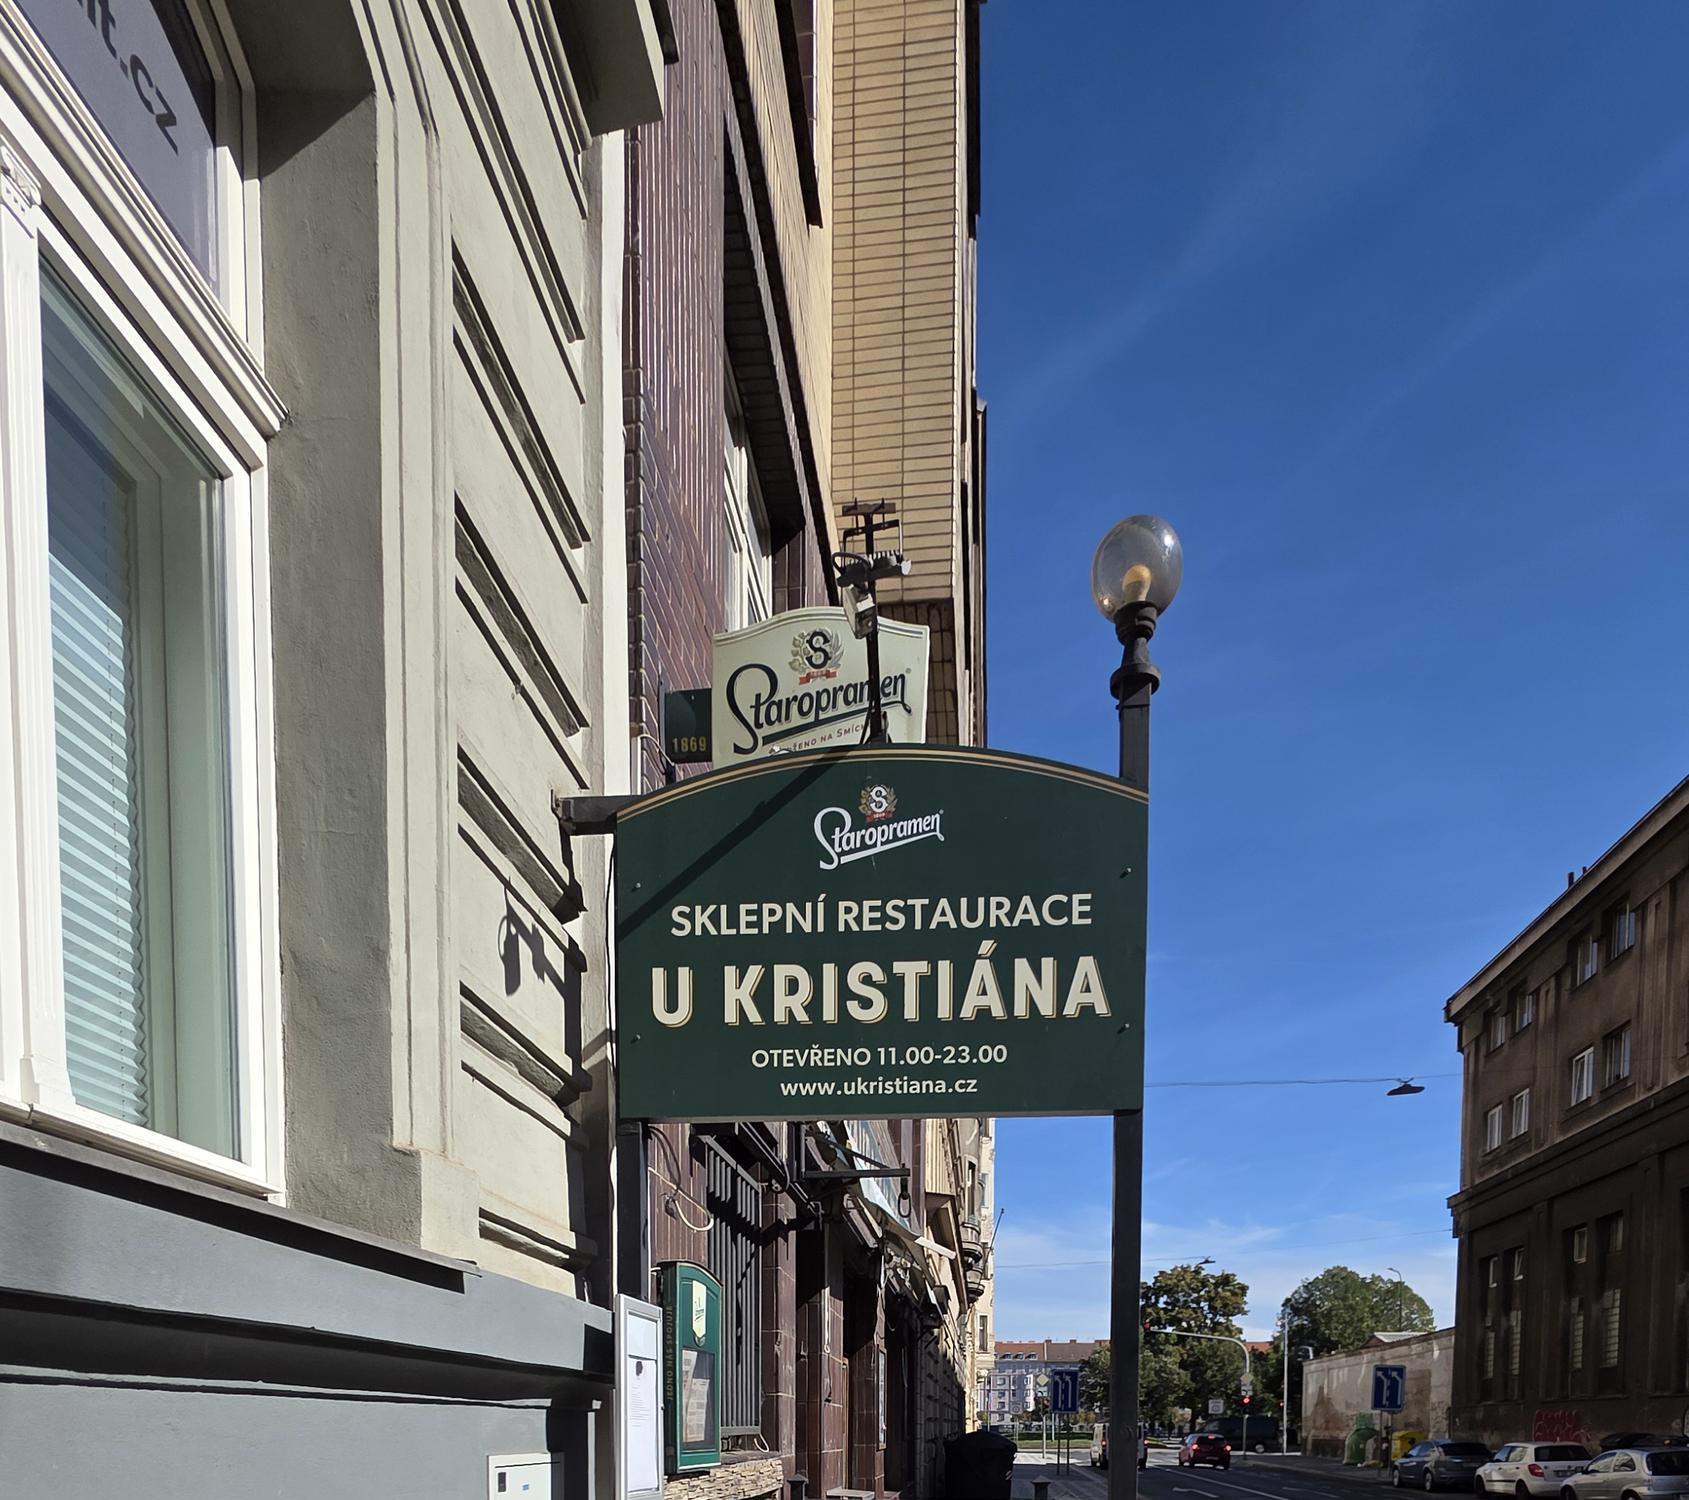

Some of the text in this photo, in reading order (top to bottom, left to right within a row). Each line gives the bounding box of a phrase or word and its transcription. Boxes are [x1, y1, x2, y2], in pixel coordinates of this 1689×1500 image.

[672, 736, 707, 752] 1869
[820, 734, 833, 742] NA
[814, 806, 944, 870] Staropramen
[671, 893, 1092, 937] SKLEPNÍ RESTAURACE
[652, 940, 1112, 1028] U KRISTIÁNA
[751, 1044, 1008, 1068] OTEVŘENO 11.00-23.00
[780, 1075, 978, 1097] www.ukristiana.cz
